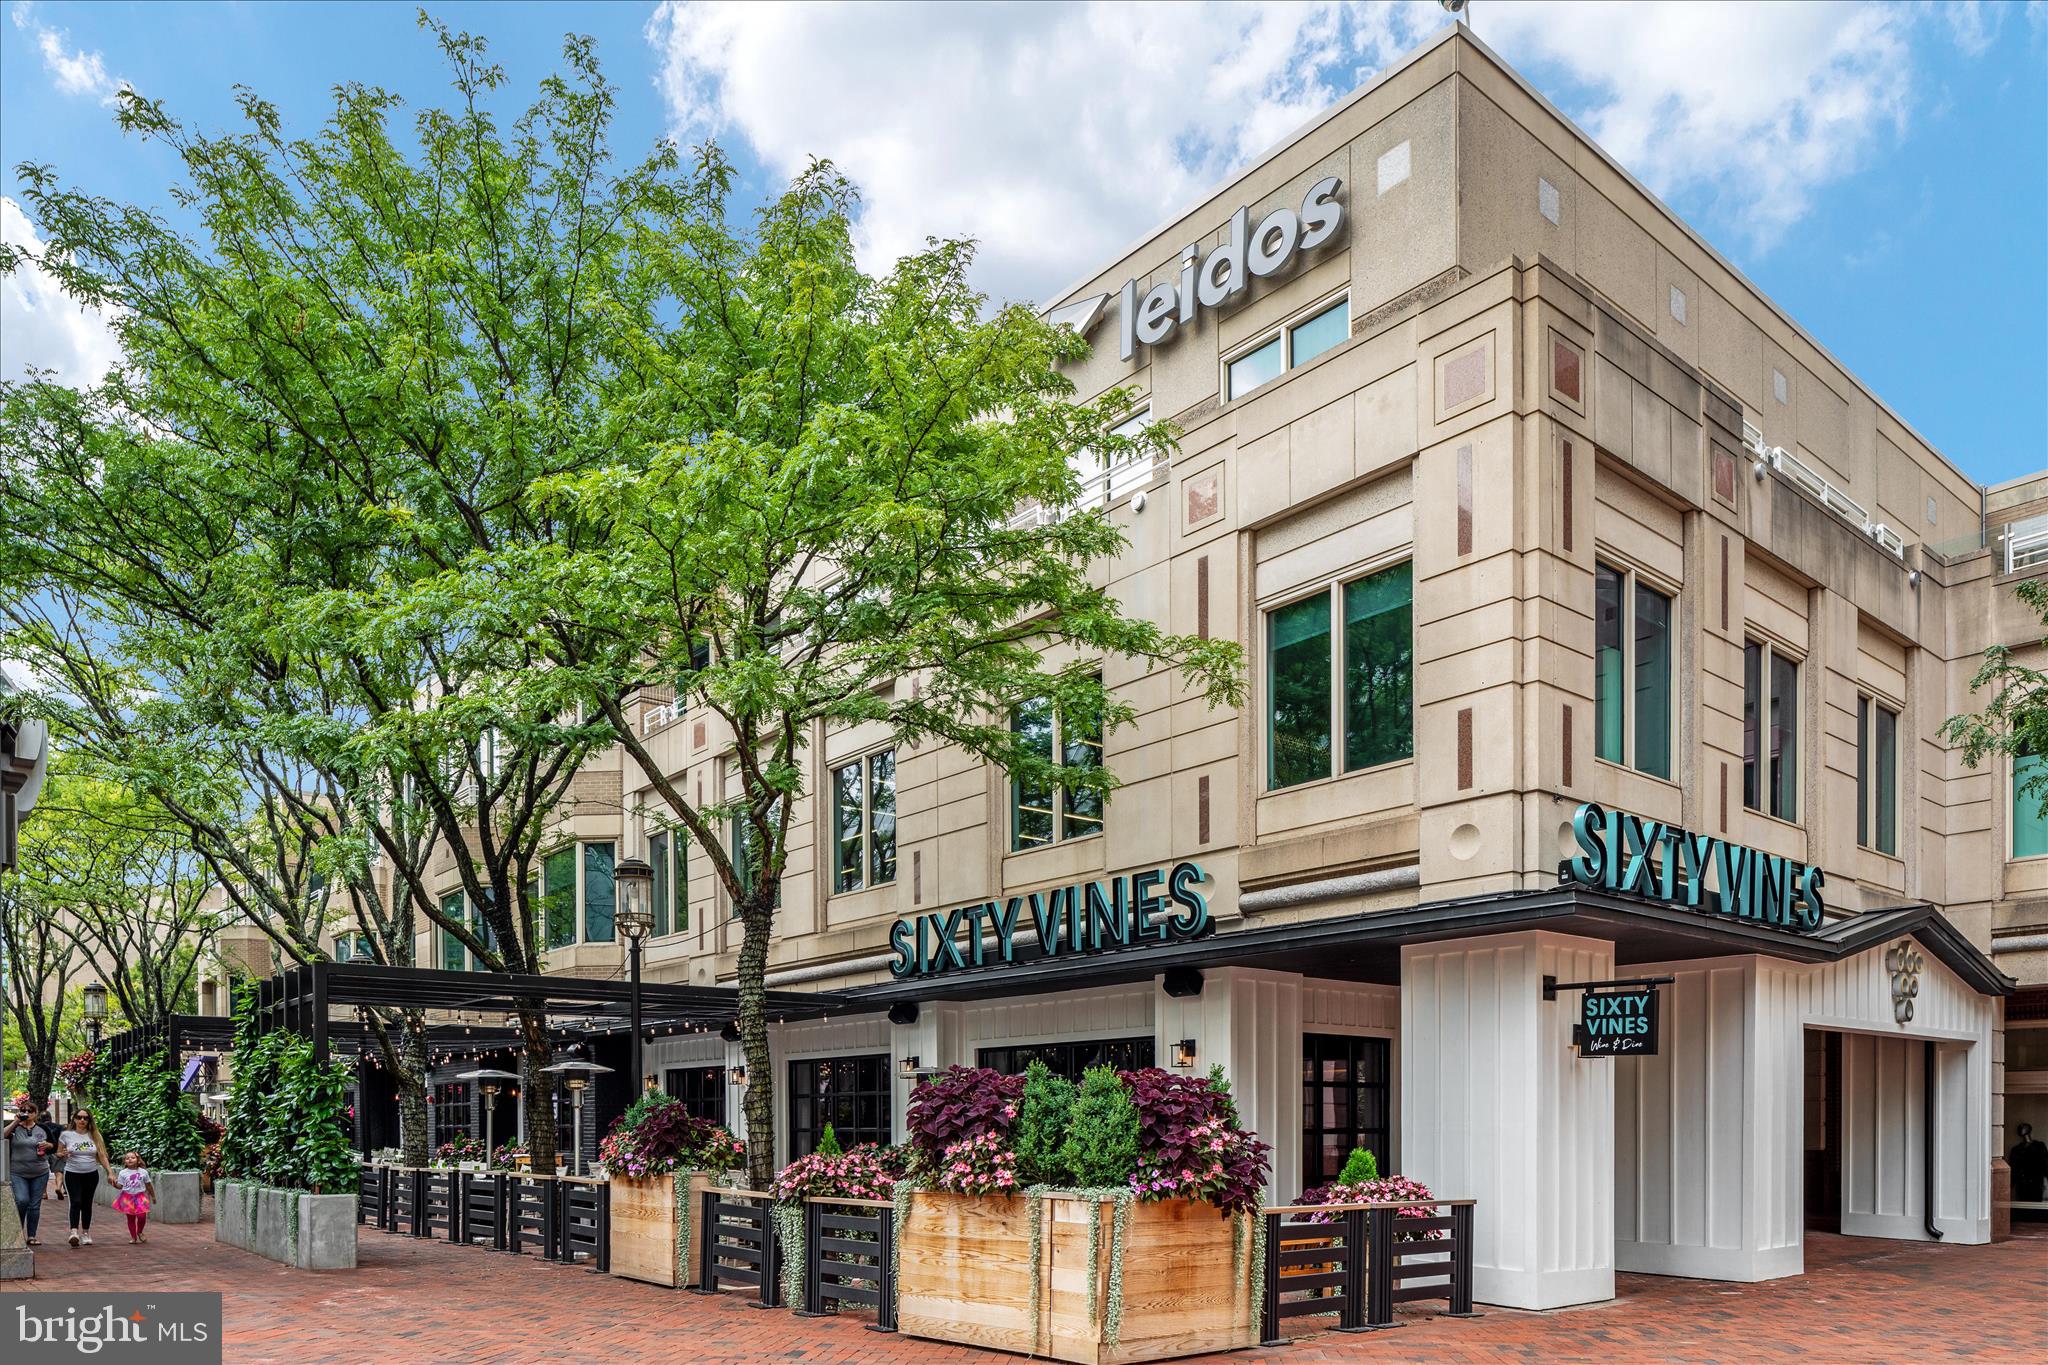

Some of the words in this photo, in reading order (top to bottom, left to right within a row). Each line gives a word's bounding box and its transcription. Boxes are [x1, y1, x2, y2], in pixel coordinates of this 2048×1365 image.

[1120, 176, 1344, 362] leidos
[1572, 803, 1715, 905] SIXTY
[1714, 840, 1825, 931] VINES
[888, 896, 1023, 979] SIXTY
[1028, 861, 1208, 956] VINES
[1586, 995, 1649, 1017] SIXTY
[1586, 1016, 1649, 1036] VINES
[1590, 1037, 1609, 1051] Wine
[1613, 1037, 1620, 1051] &
[1622, 1038, 1643, 1050] Dine
